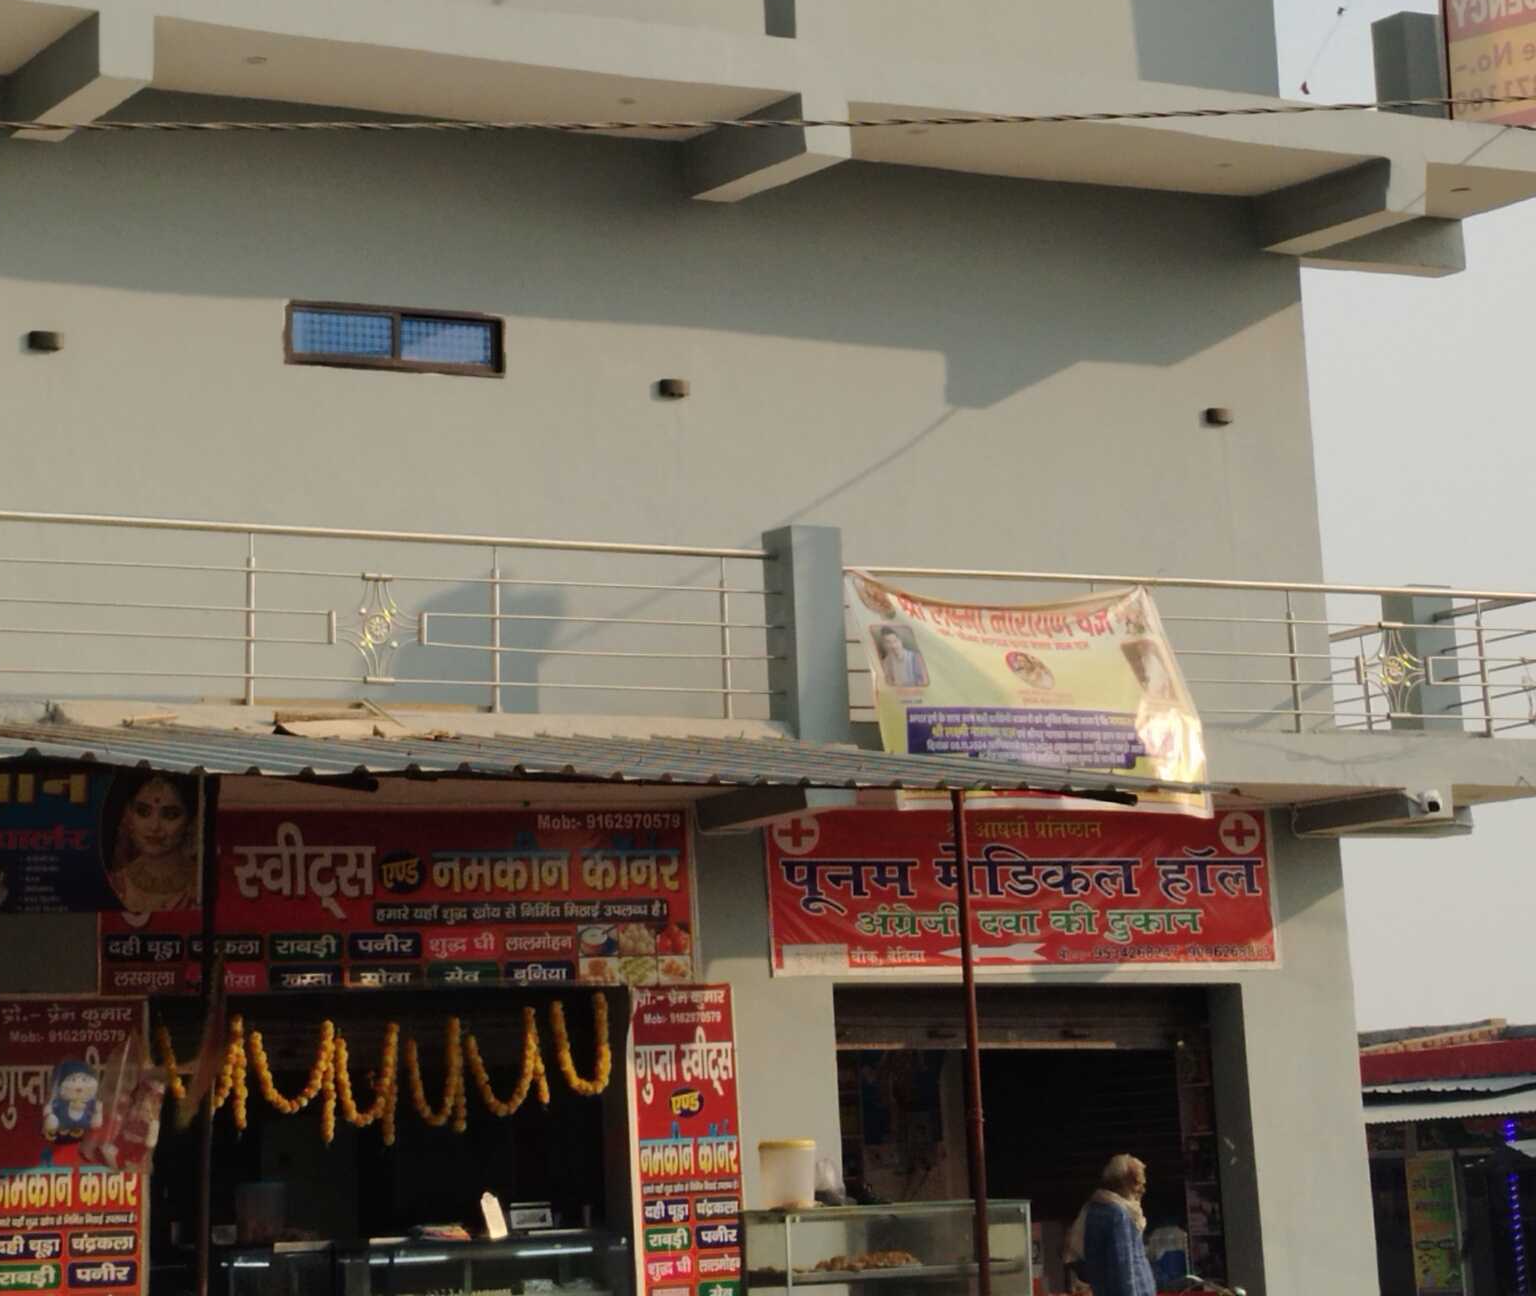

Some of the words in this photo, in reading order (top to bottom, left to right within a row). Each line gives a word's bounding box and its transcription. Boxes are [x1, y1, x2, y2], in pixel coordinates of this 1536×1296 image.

[232, 820, 377, 921] स्वीट्स
[431, 831, 570, 894] नमकीन
[779, 858, 920, 915] पूनम
[932, 842, 1142, 898] मेडिकल
[1155, 846, 1263, 904] हॉल
[356, 933, 414, 955] पनीर
[854, 902, 962, 938] अंग्रेजी
[977, 909, 1042, 938] दवा
[1048, 900, 1099, 937] की
[1104, 907, 1204, 945] दुकान
[635, 1044, 677, 1105] गुप्ता
[680, 1025, 733, 1096] स्वीट्स
